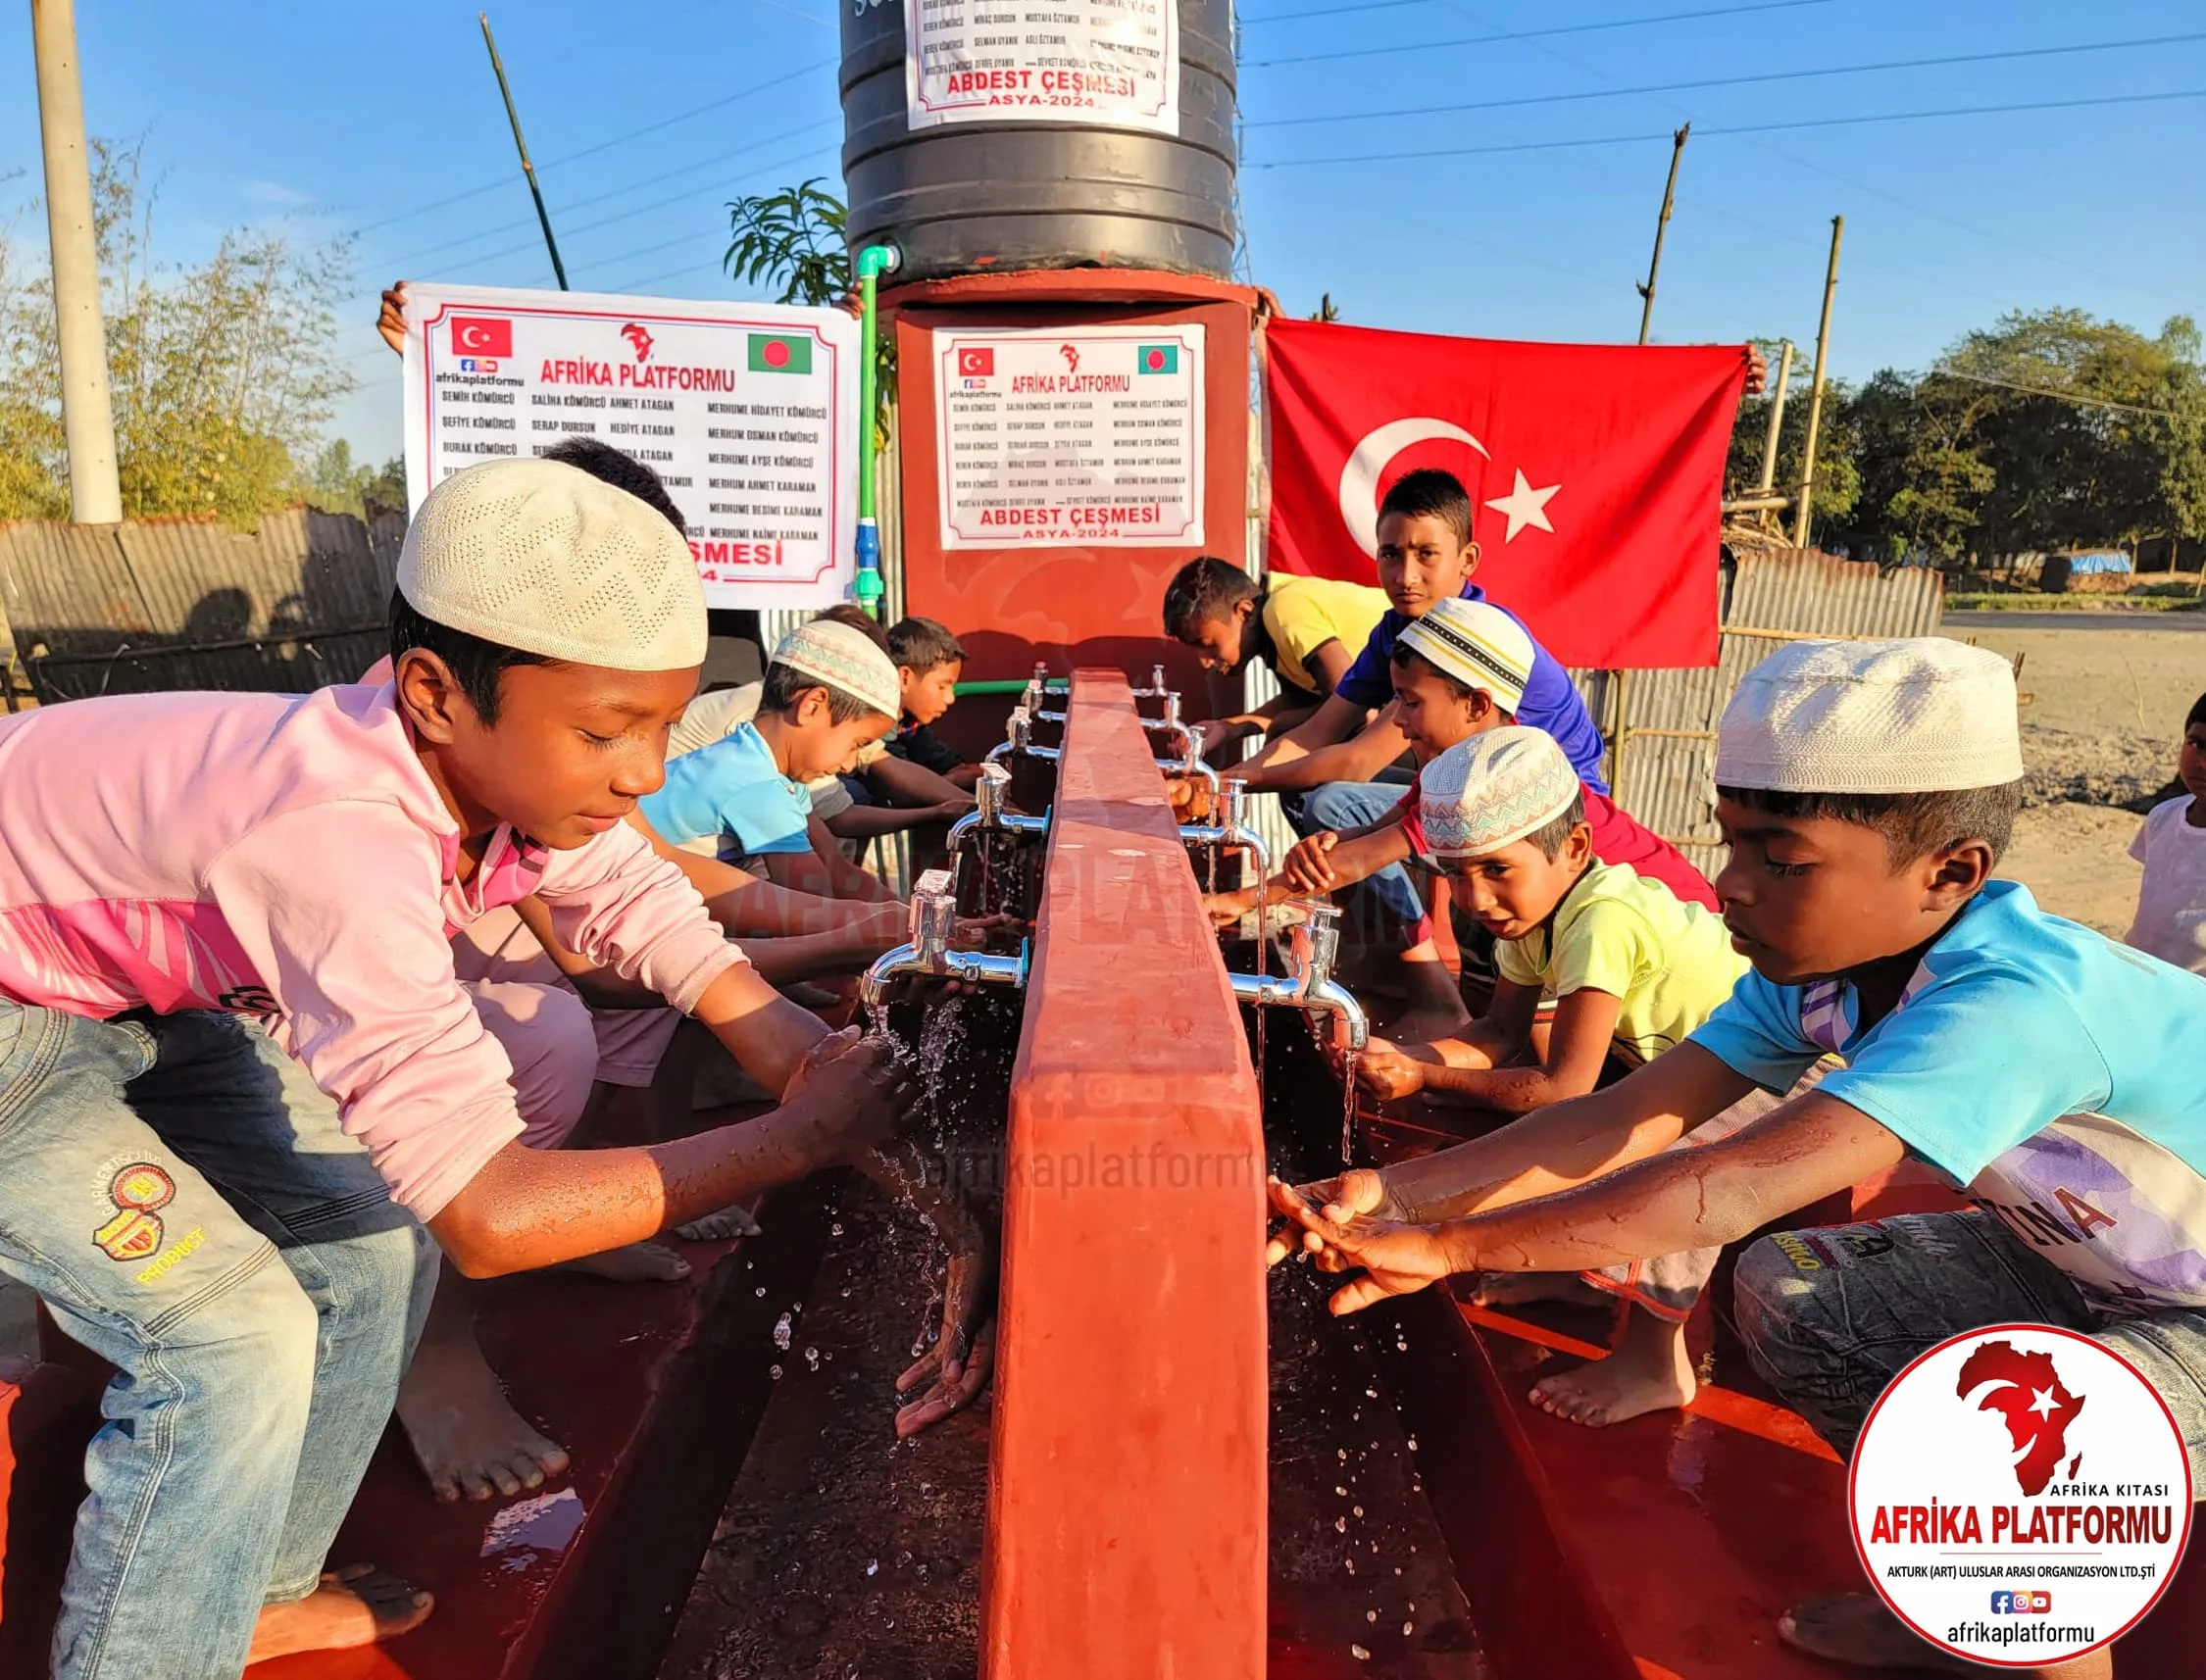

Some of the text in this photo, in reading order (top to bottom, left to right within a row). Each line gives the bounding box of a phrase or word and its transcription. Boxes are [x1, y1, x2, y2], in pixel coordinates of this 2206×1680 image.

[947, 70, 1032, 94] ABDEST
[988, 94, 1095, 107] ASYA-2024
[435, 371, 525, 387] afrikaplatformu
[541, 356, 736, 393] AFRİKA PLATFORMU
[1012, 371, 1130, 393] AFRİKA PLATFORMU
[610, 397, 638, 410] AHMET
[707, 402, 748, 416] MERHUME
[708, 452, 749, 466] MERHUME
[979, 501, 1161, 529] ABDEST ÇEŞMESİ
